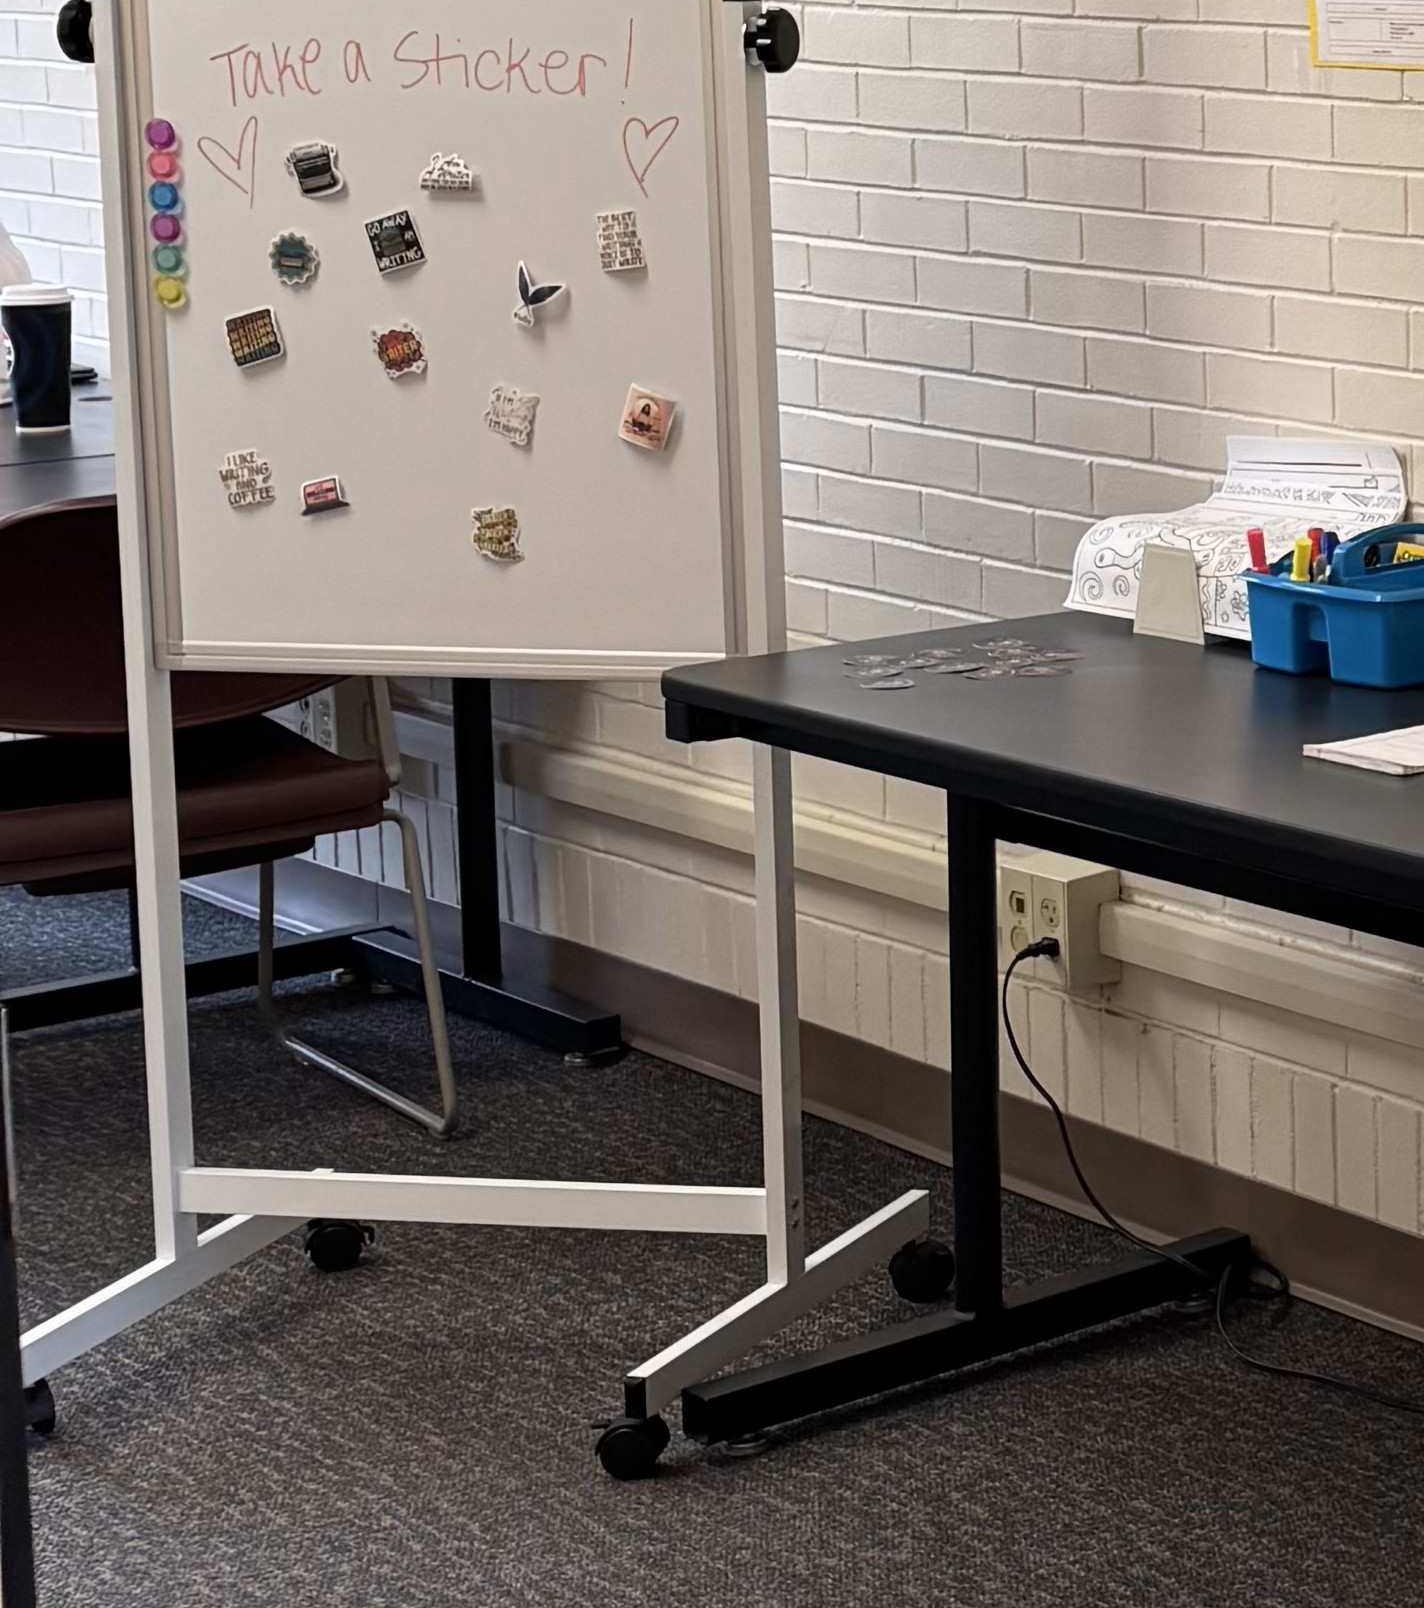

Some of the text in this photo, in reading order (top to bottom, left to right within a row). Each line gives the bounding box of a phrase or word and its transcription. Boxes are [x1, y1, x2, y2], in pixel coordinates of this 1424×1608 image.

[344, 42, 370, 83] a
[368, 212, 407, 236] GO AWAY
[377, 246, 423, 269] WRITING
[234, 451, 257, 467] LIKE
[219, 462, 269, 482] WRITING
[228, 485, 274, 505] COFFEE
